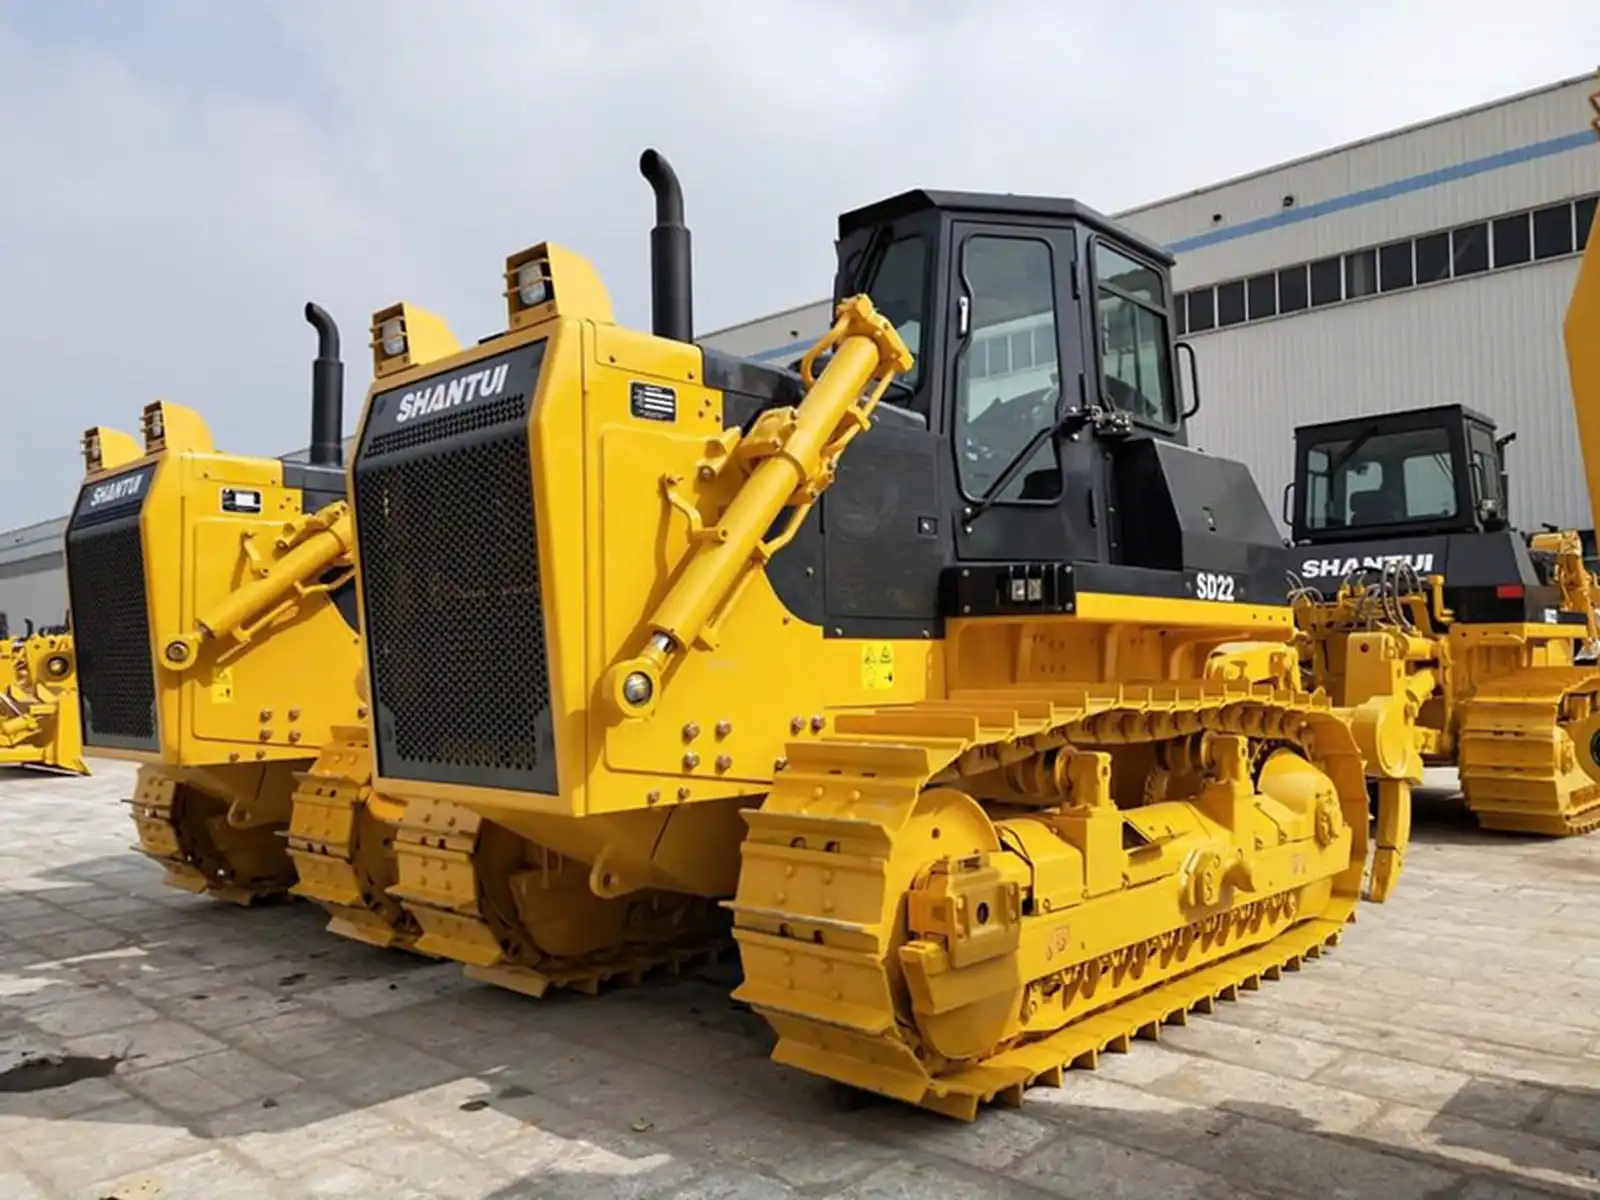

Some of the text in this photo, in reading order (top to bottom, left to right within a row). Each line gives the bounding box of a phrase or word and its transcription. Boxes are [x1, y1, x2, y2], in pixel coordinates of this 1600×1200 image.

[396, 364, 510, 422] SHANTUI
[90, 474, 143, 506] SHANTUI
[1196, 572, 1235, 602] SD22
